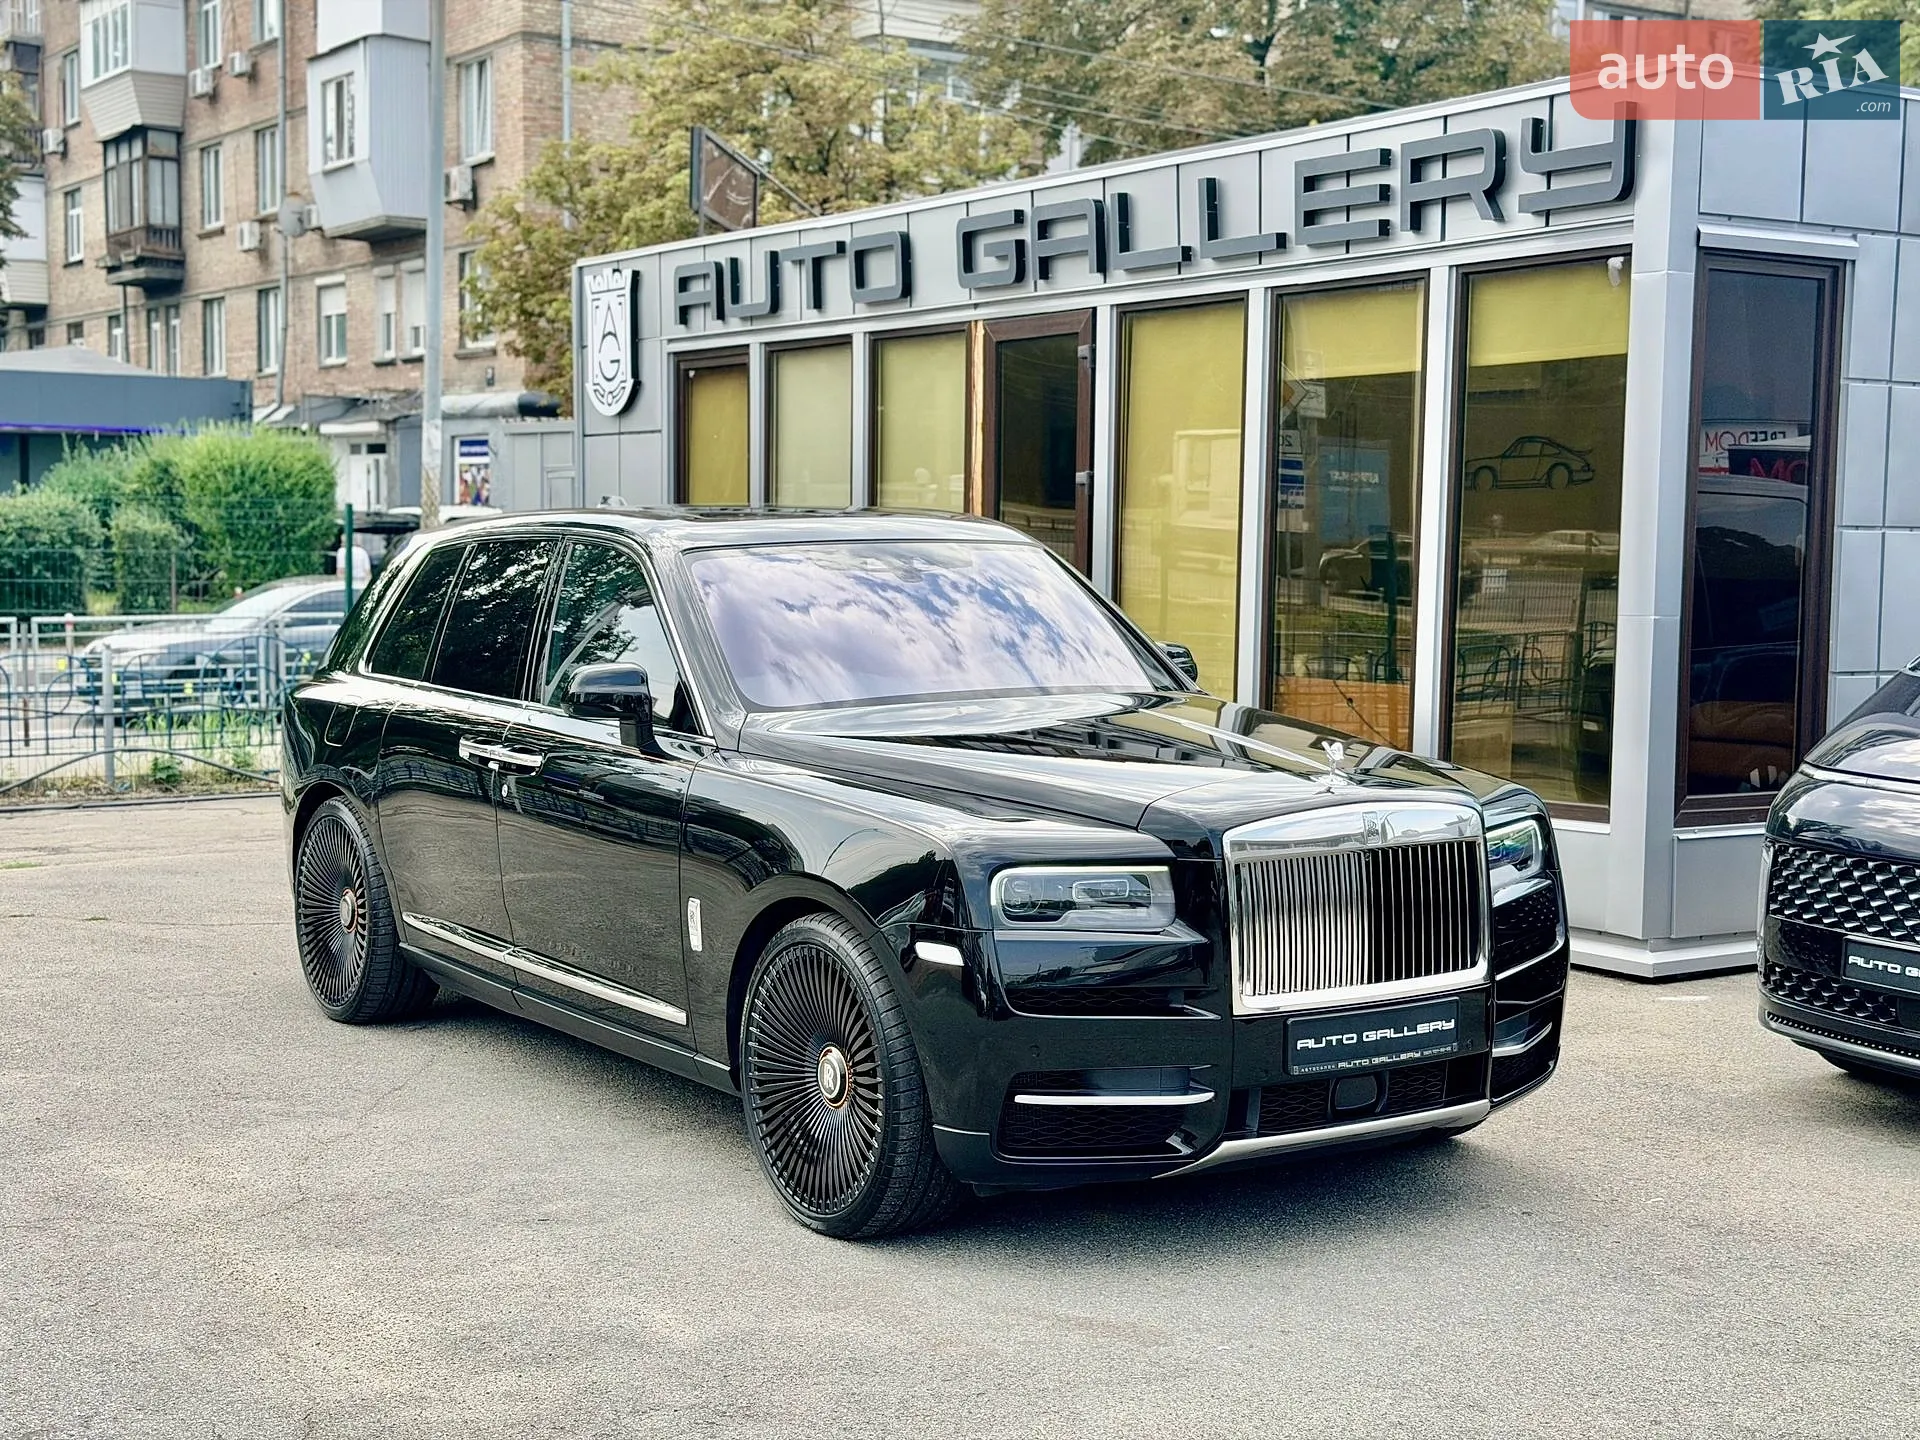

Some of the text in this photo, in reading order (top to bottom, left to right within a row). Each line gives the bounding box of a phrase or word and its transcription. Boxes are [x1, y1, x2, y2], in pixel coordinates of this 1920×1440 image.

[673, 101, 1641, 327] AUTO GALLERY
[1848, 955, 1920, 978] AUTO G
[1296, 1018, 1455, 1051] AUTO GALLERY
[1338, 1058, 1370, 1069] AUTO
[1371, 1050, 1421, 1064] GALLERY
